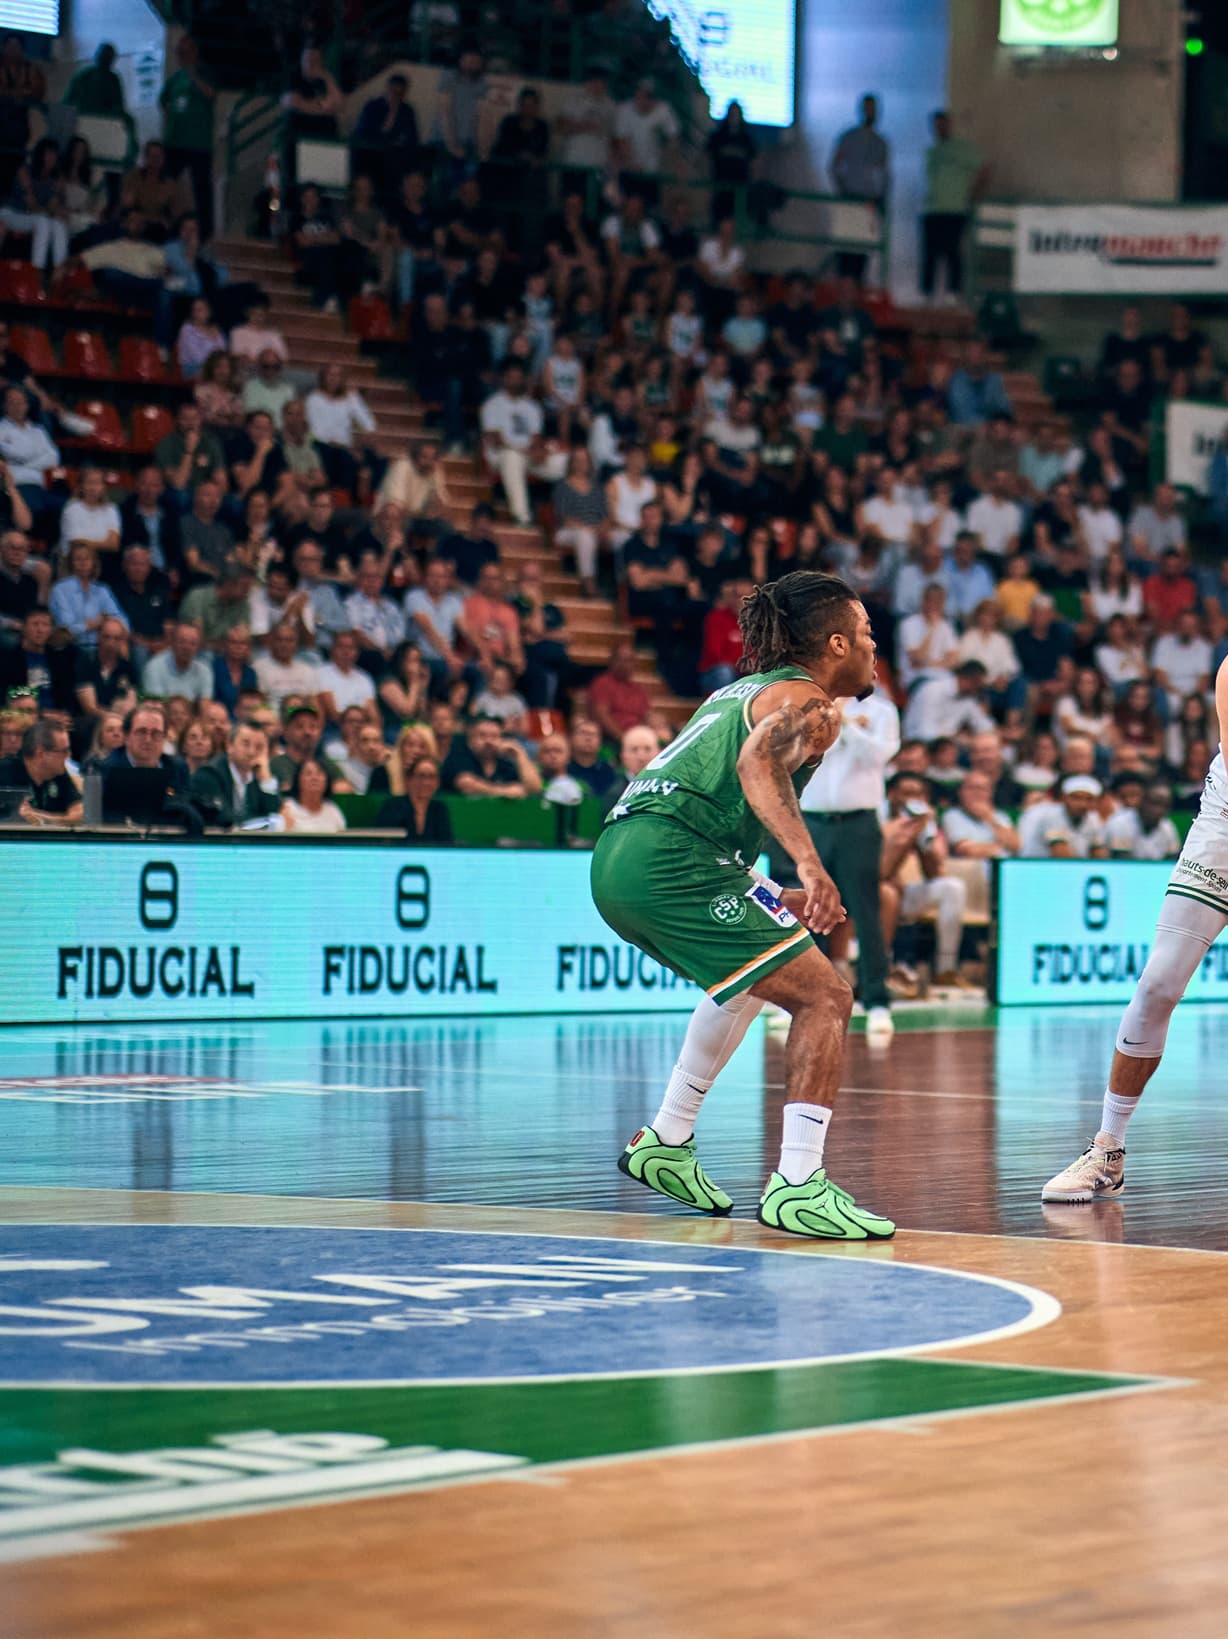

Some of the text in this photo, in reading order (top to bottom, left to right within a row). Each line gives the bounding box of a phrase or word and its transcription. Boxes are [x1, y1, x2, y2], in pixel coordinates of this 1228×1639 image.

[713, 896, 740, 920] CSP
[57, 946, 255, 999] FIDUCIAL
[322, 944, 498, 995] FIDUCIAL
